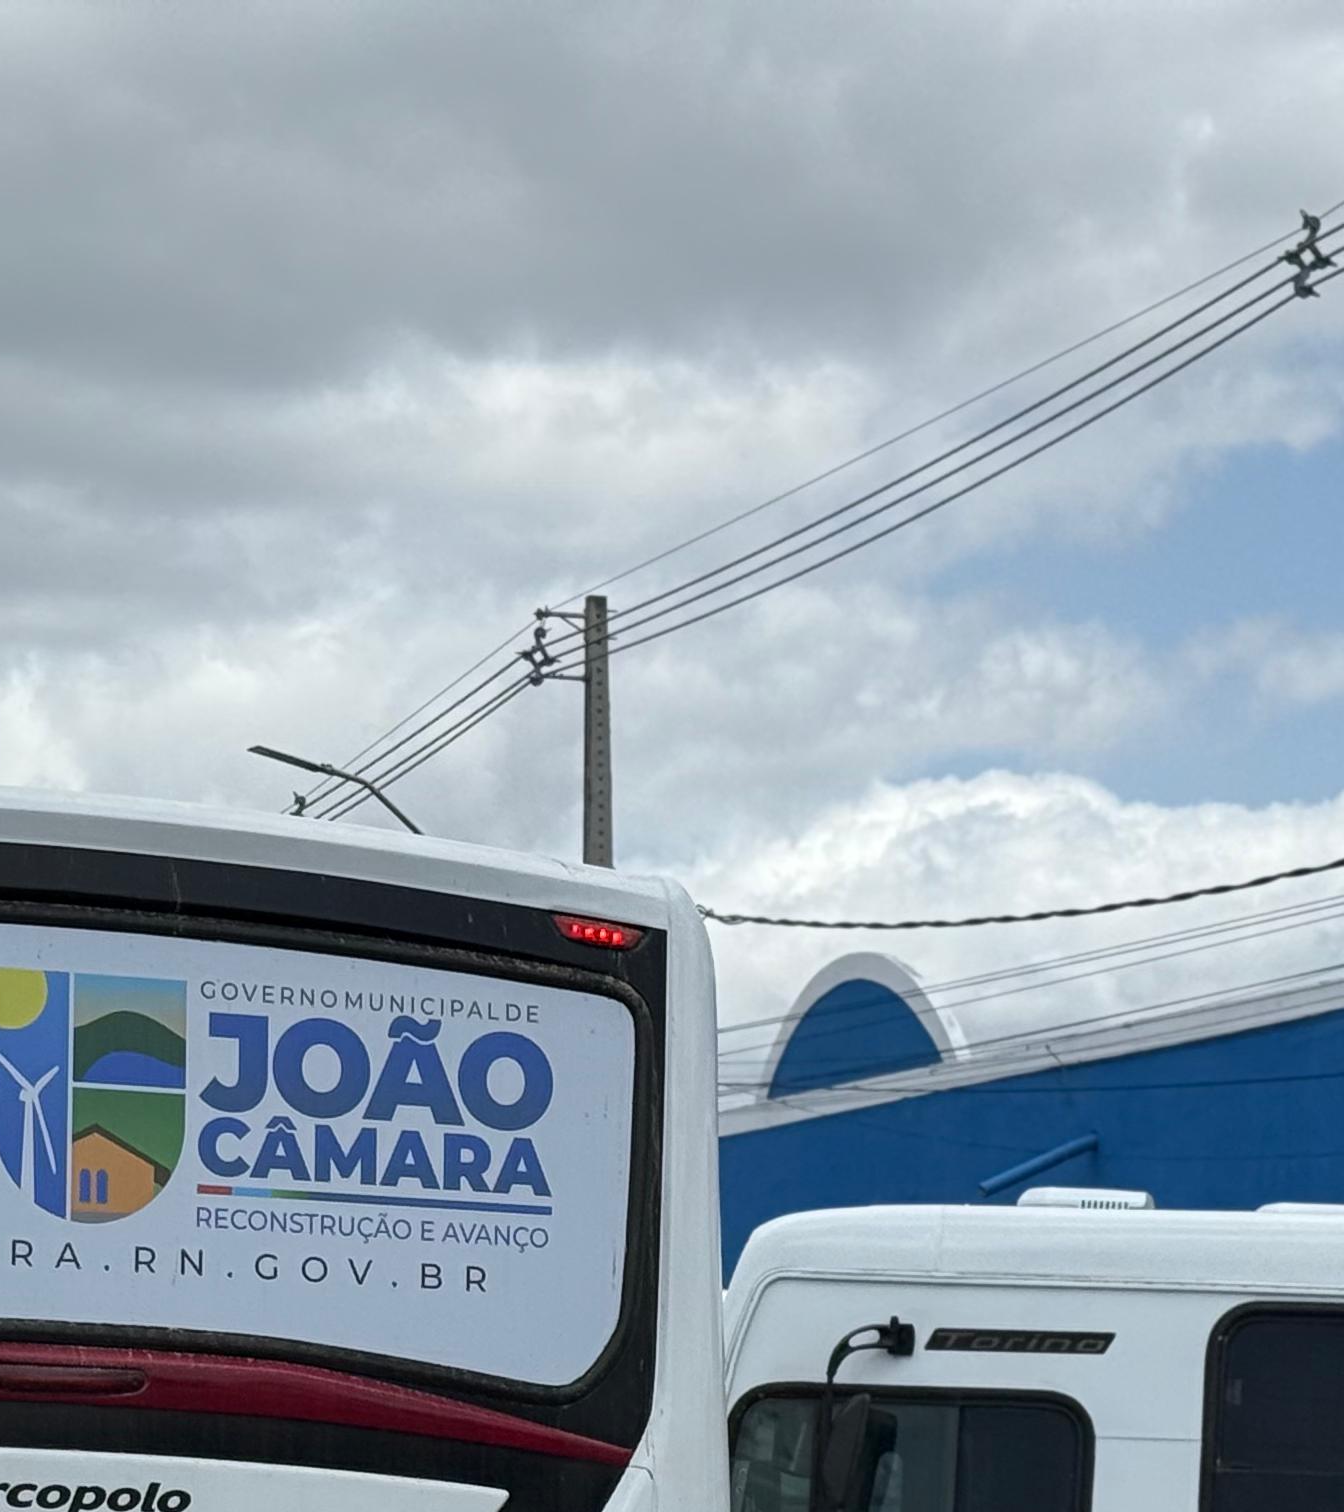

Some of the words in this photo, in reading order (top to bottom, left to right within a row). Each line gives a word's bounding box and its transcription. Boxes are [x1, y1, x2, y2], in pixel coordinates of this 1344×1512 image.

[199, 1012, 555, 1132] JOÃO
[197, 1115, 553, 1197] CÂMARA
[195, 1206, 413, 1244] RECONSTRUÇÃO
[420, 1220, 435, 1242] E
[441, 1221, 550, 1254] AVANÇO
[936, 1331, 1107, 1353] Torino
